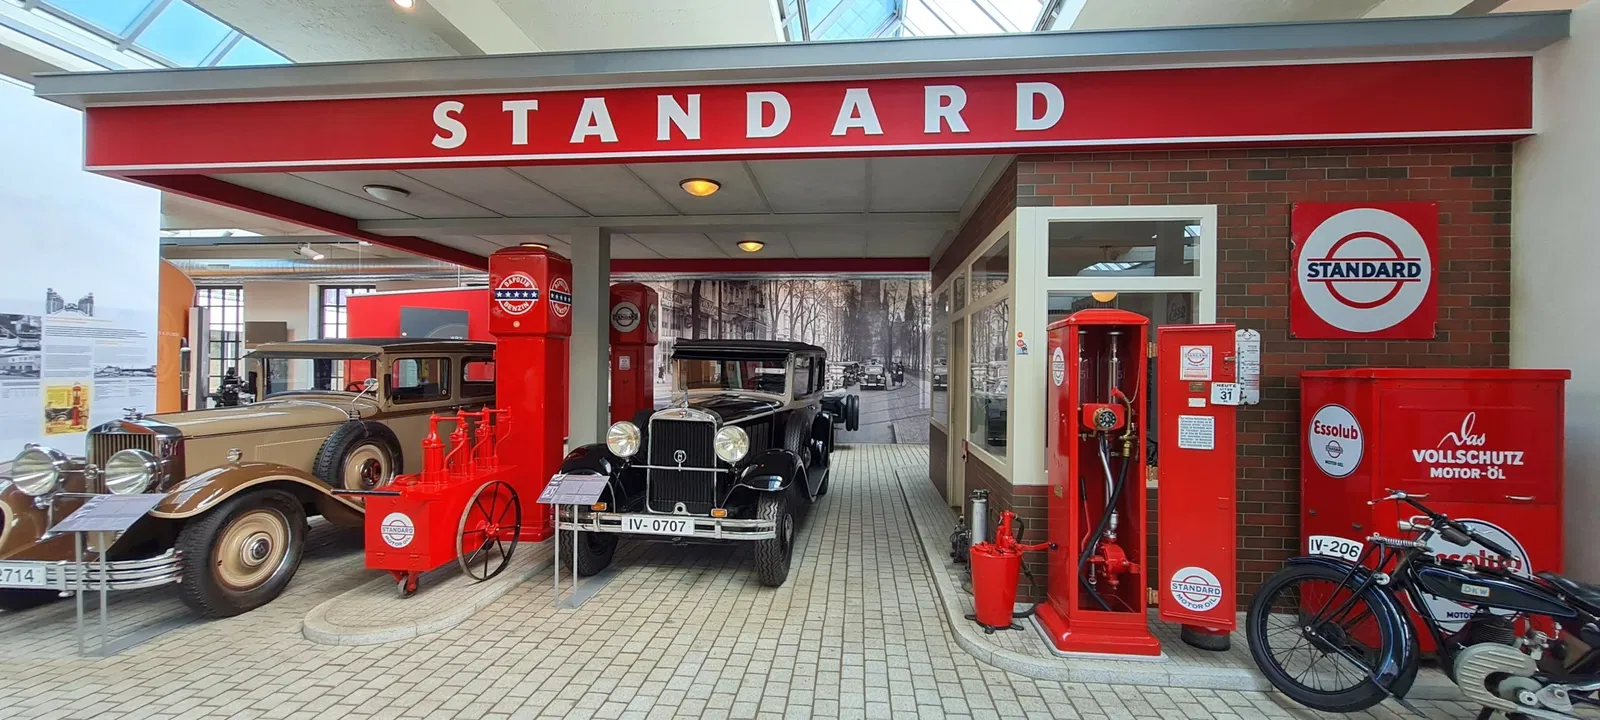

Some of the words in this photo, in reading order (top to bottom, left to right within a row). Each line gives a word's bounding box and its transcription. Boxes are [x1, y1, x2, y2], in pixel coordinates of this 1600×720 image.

[431, 82, 1066, 150] STANDARD
[1307, 262, 1422, 278] STANDARD
[503, 276, 531, 288] DAPOLIN
[503, 300, 530, 312] BENZIN
[1220, 391, 1232, 401] 31
[1313, 420, 1358, 440] Essolub
[1412, 449, 1524, 465] VOLLSCHUTZ
[1430, 466, 1506, 480] MOTOR-ÖL
[382, 525, 413, 534] STANDARD
[652, 519, 686, 532] 0707
[385, 535, 402, 546] MOTOR
[403, 536, 411, 545] OIL
[1310, 539, 1360, 558] IV-206
[0, 568, 34, 583] 714
[1172, 582, 1221, 595] STANDARD
[1464, 585, 1488, 596] DKW
[1176, 593, 1204, 609] MOTOR
[1204, 598, 1218, 608] OIL
